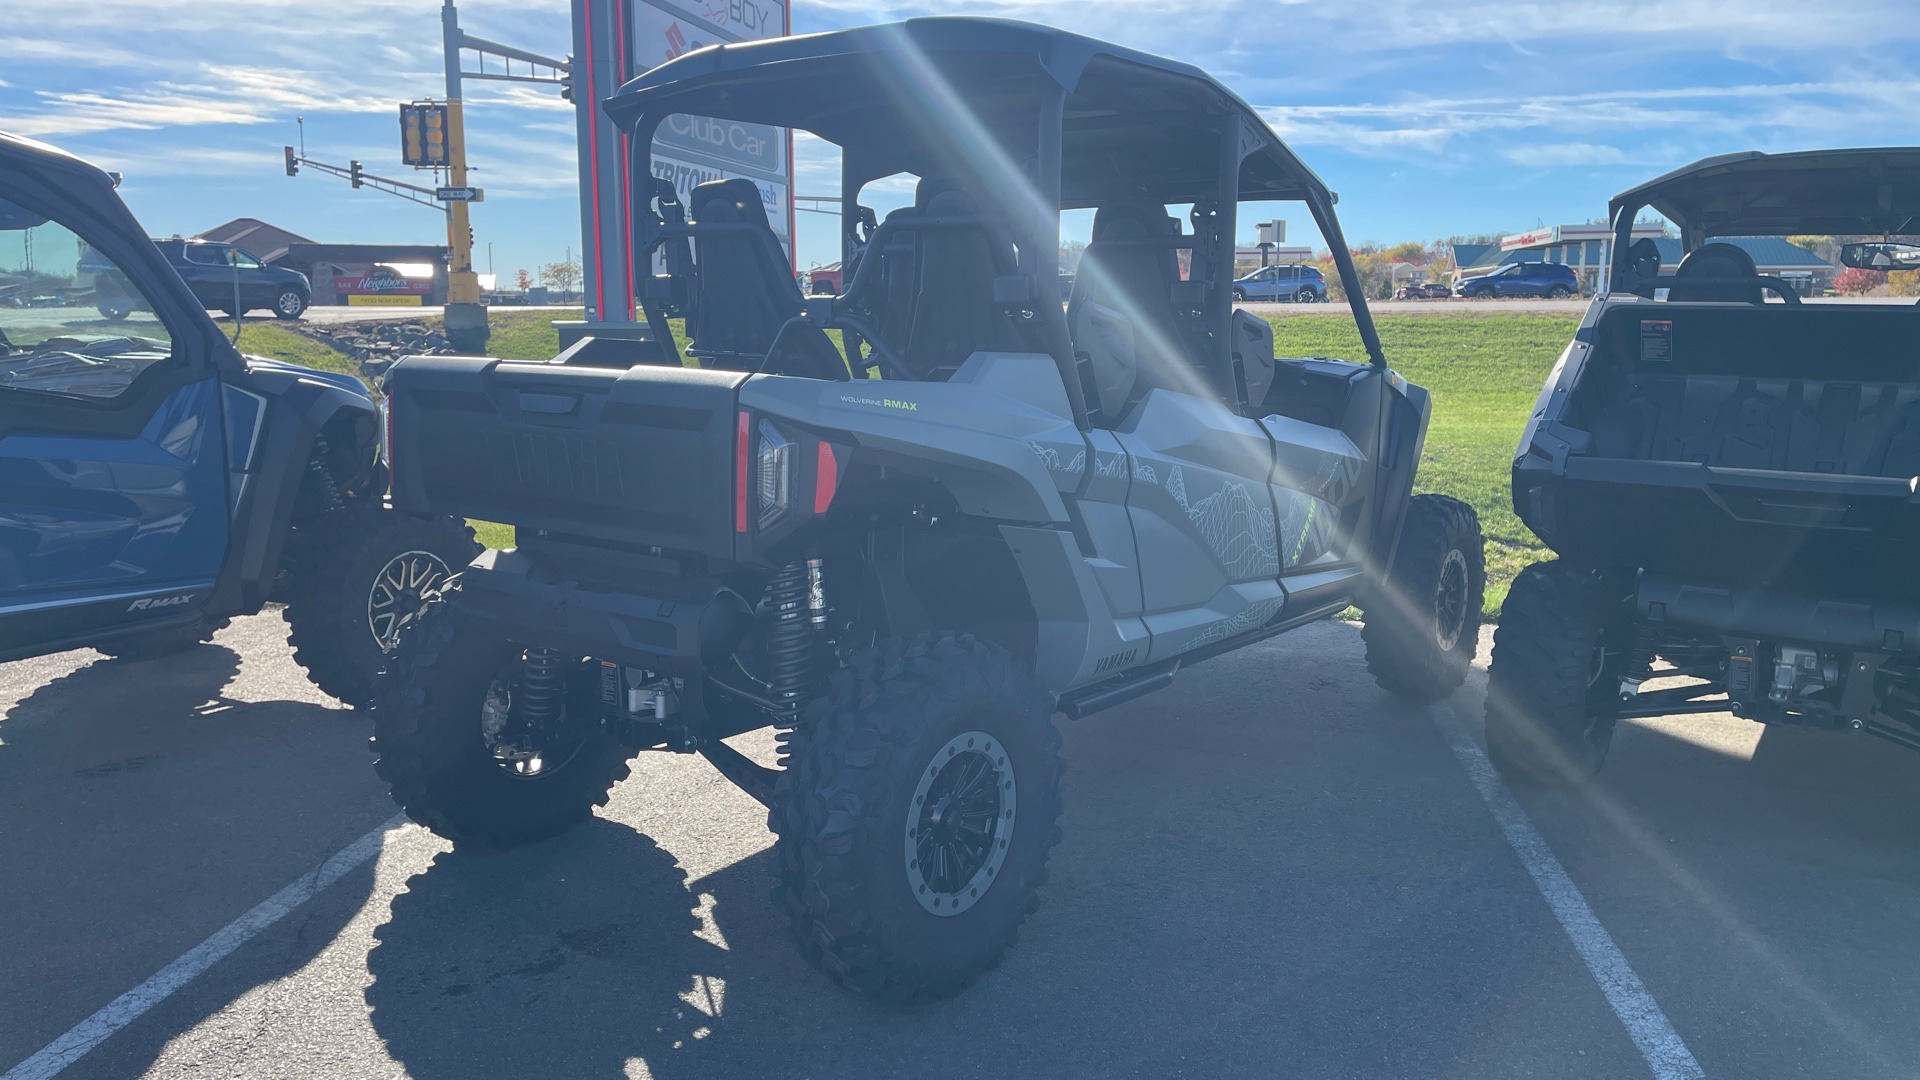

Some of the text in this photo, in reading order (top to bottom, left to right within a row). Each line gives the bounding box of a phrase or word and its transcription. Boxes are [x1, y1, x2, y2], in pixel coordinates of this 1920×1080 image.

[730, 0, 769, 35] BOY
[668, 113, 766, 157] Club Car
[840, 395, 918, 411] WOLVERINE RMAX
[126, 594, 195, 612] RMAX
[1094, 648, 1137, 674] YAMAHA
